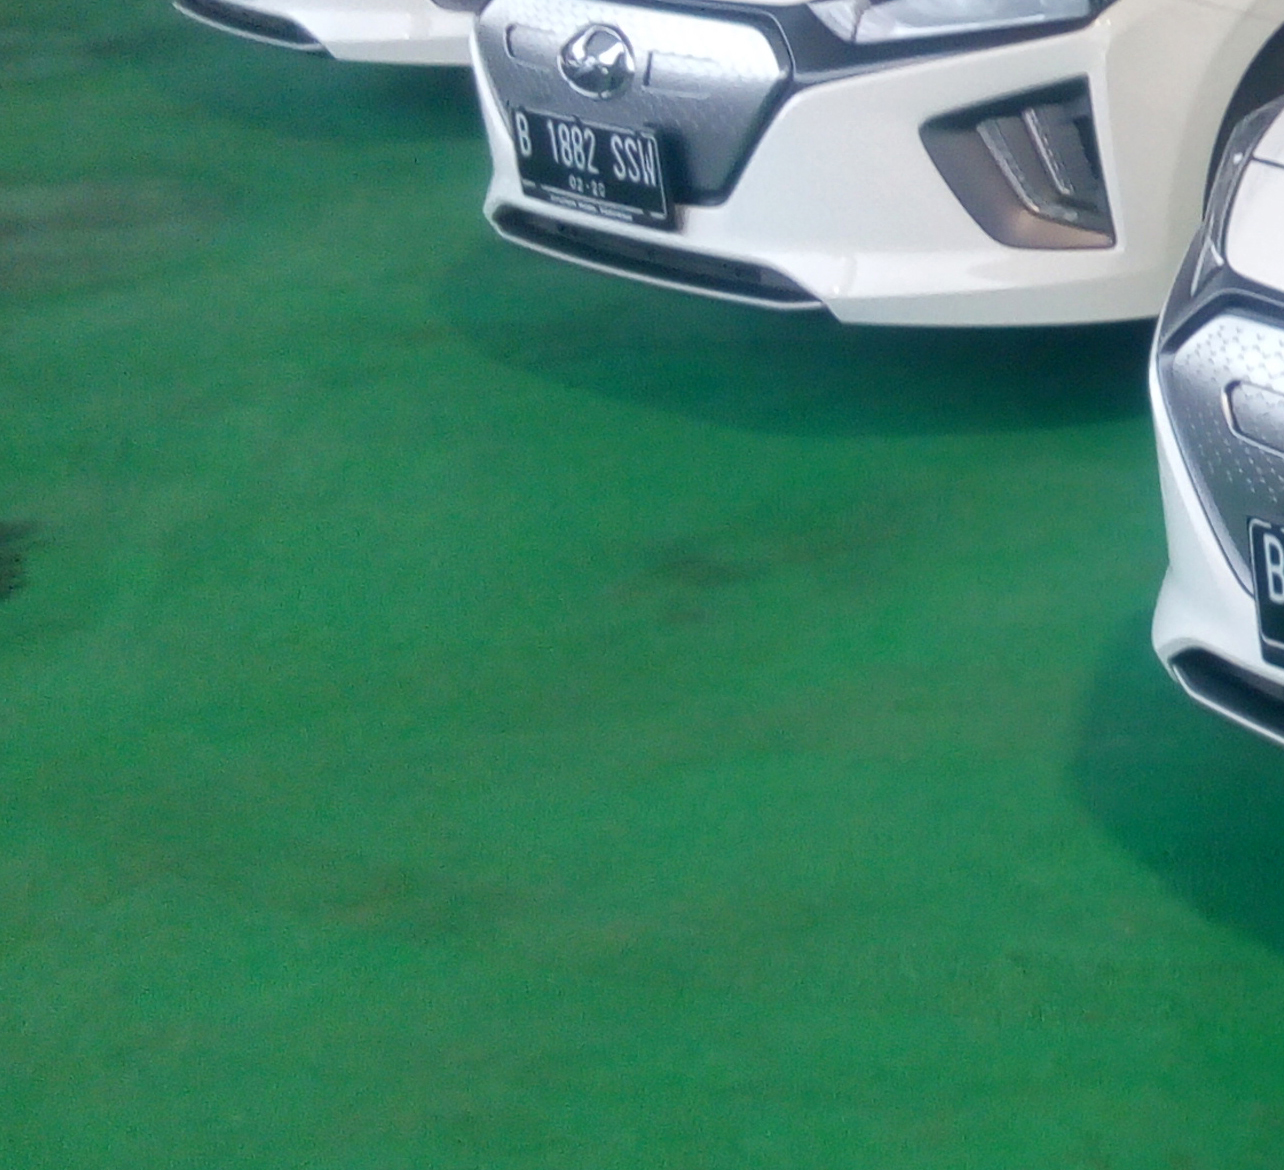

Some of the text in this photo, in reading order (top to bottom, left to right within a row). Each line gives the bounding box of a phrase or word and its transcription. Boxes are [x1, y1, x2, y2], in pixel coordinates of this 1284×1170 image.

[515, 111, 656, 188] B 1882 SSW
